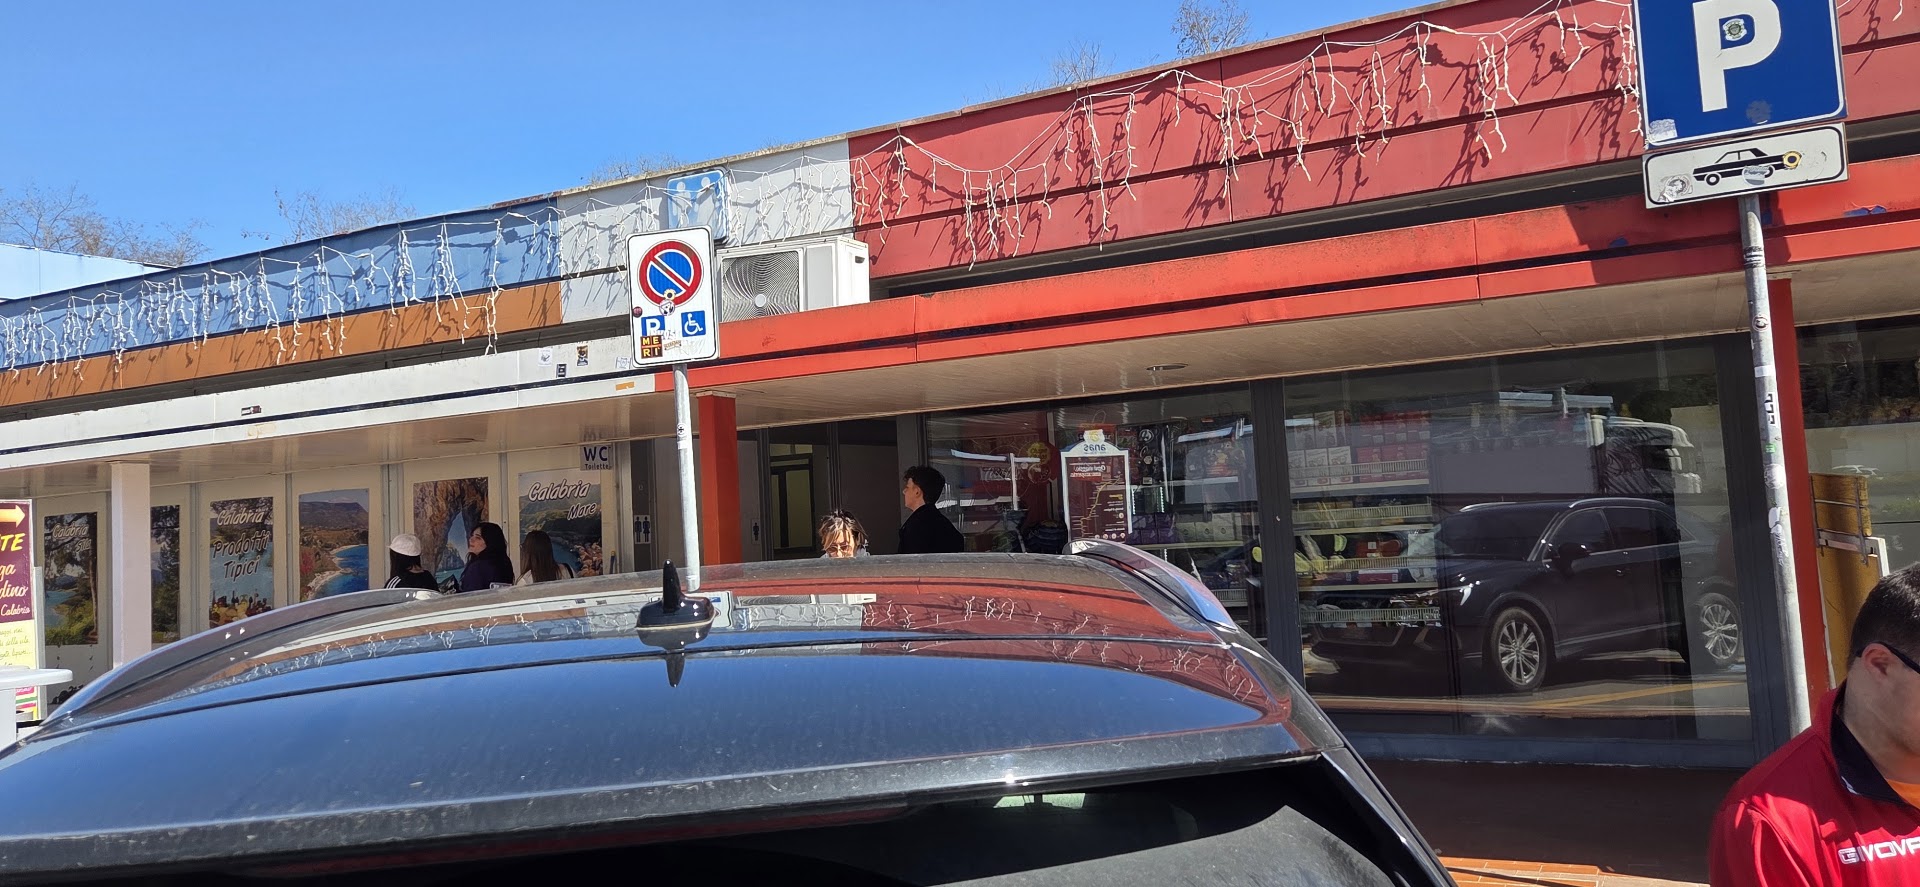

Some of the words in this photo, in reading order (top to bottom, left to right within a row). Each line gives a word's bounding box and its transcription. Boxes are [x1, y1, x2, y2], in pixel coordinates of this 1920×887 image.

[1692, 0, 1781, 112] P
[645, 318, 661, 336] P
[583, 446, 608, 462] WC
[528, 479, 591, 502] Calabria
[217, 507, 265, 526] Calabria
[567, 502, 597, 521] Mare
[52, 521, 88, 539] Calabria
[212, 530, 271, 559] Prodotti
[223, 555, 261, 582] Tipici
[0, 603, 31, 616] Calabria
